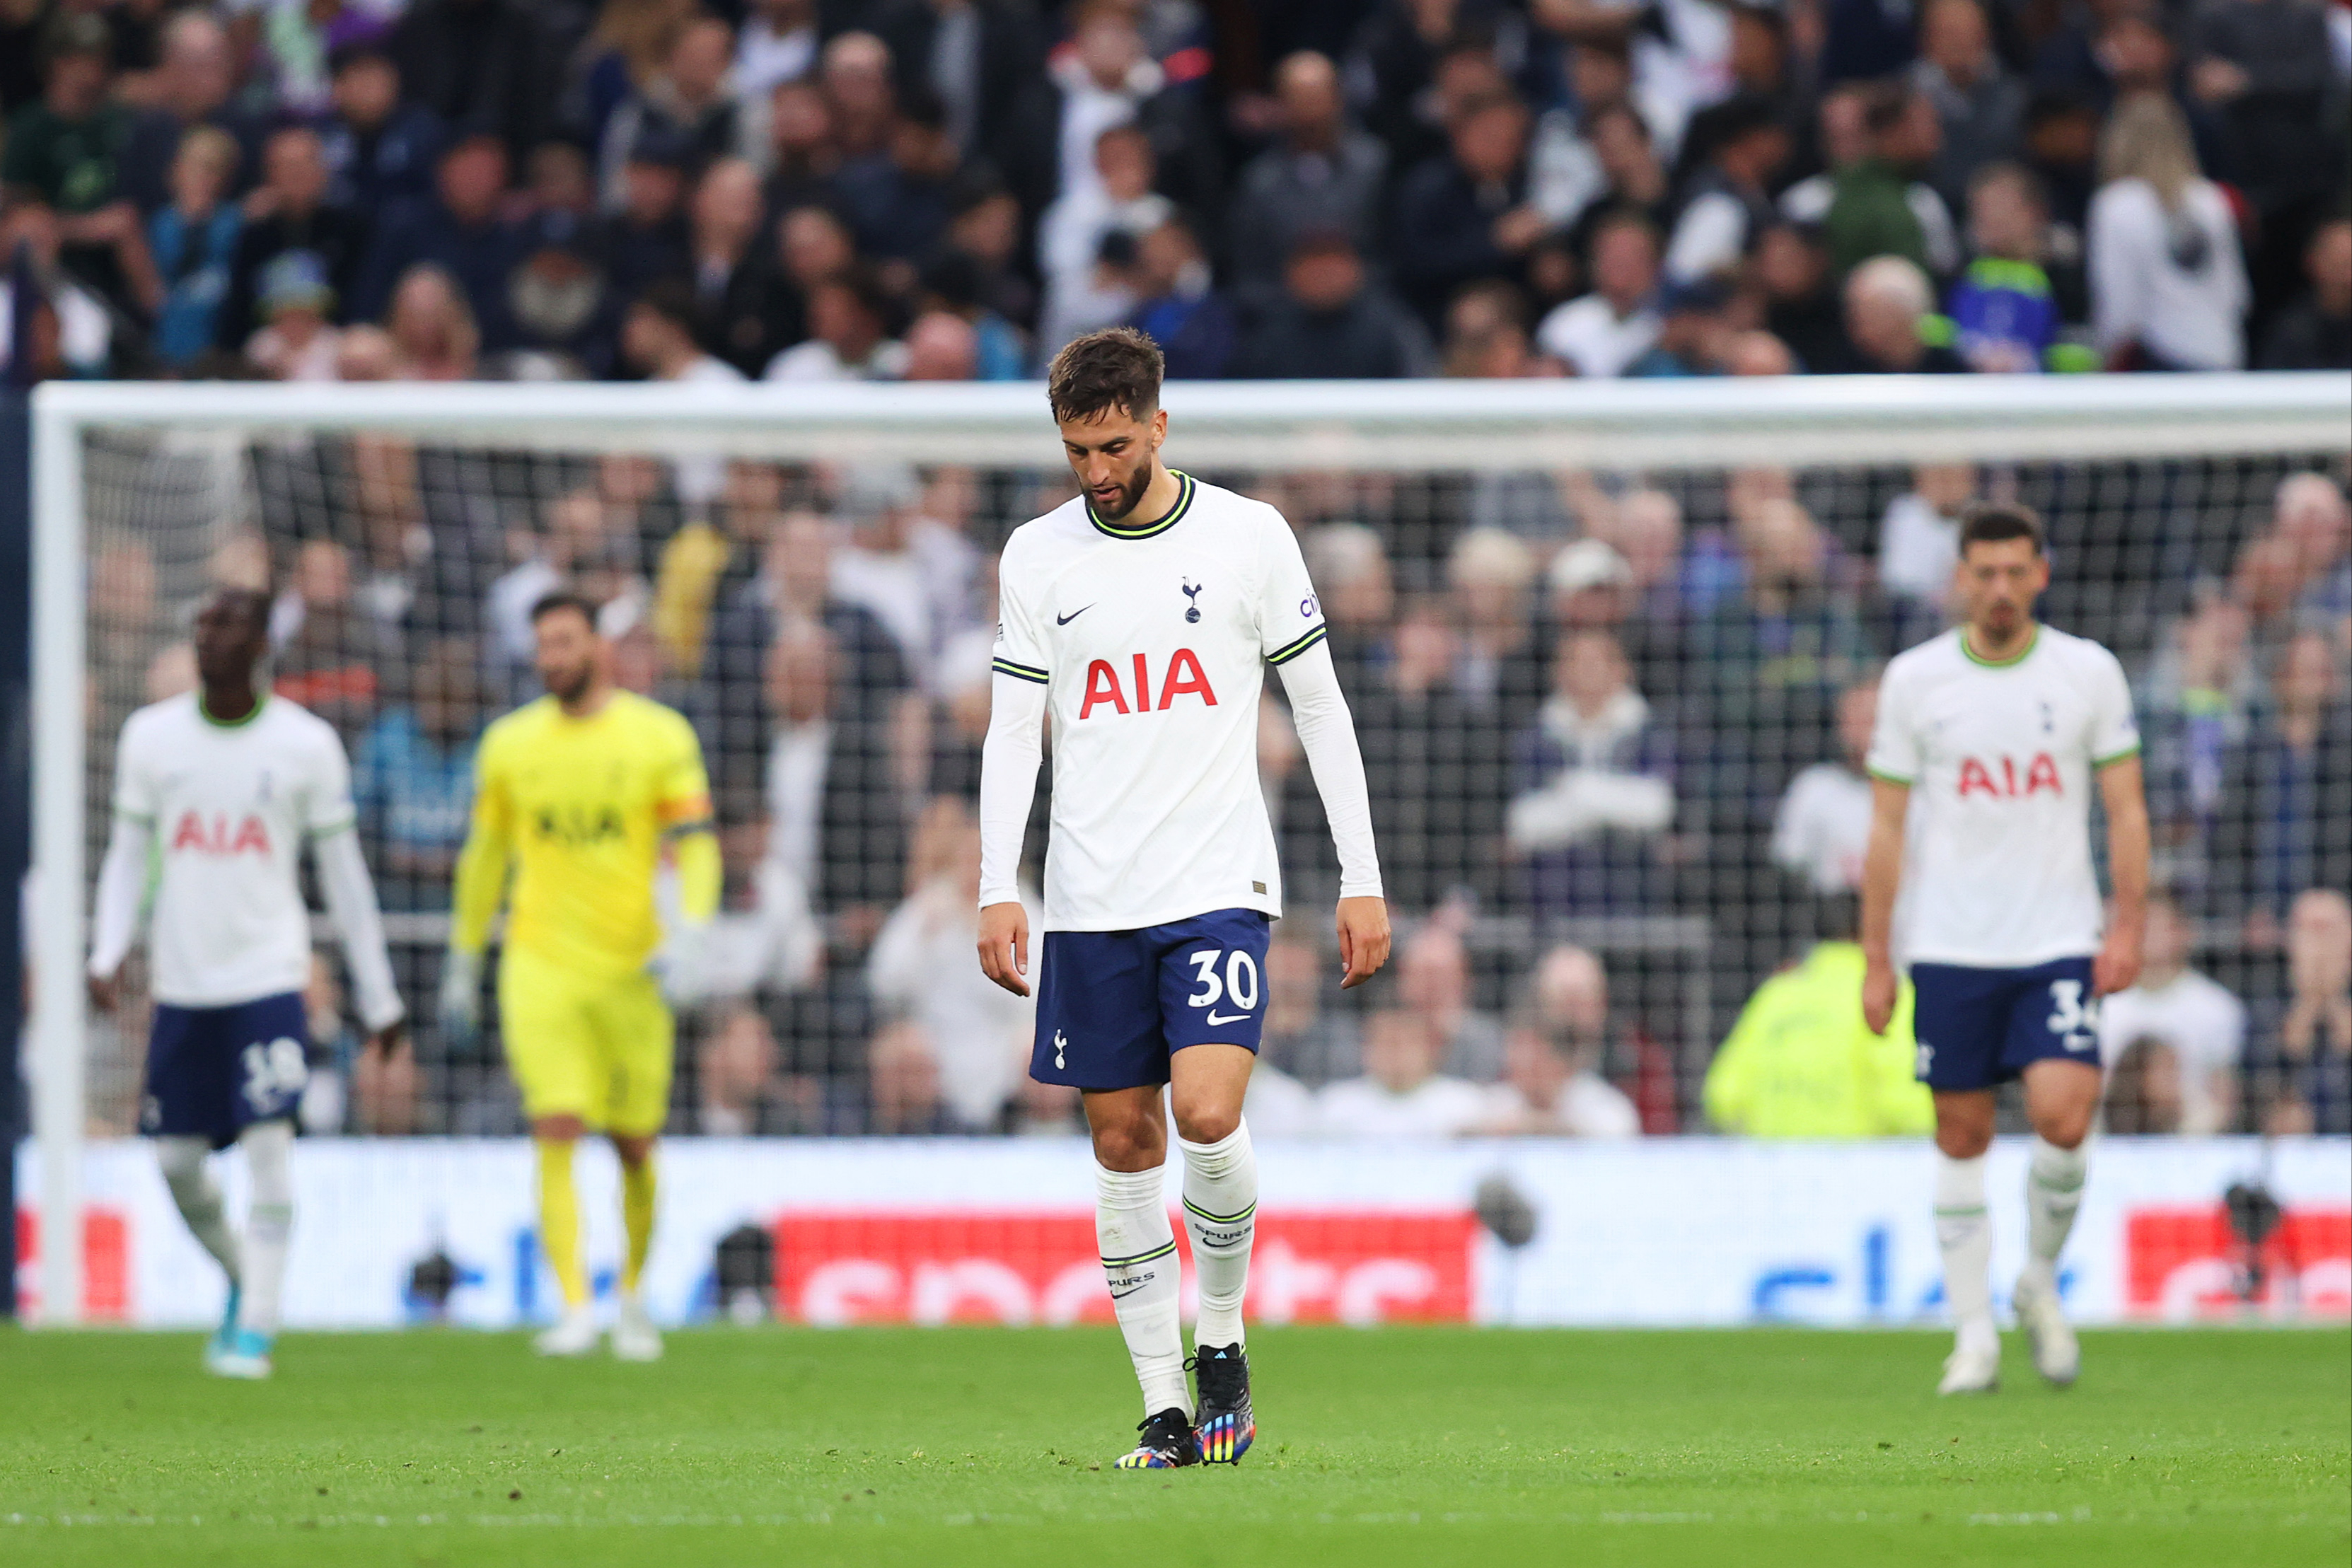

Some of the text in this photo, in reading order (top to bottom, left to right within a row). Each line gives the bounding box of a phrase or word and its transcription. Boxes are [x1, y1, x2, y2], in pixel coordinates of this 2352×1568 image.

[1079, 648, 1218, 720] AIA
[1959, 750, 2066, 798] AIA
[172, 808, 272, 854] AIA
[1188, 949, 1258, 1010] 30
[2046, 979, 2099, 1034] 3
[1194, 1224, 1252, 1240] SPURS
[1106, 1272, 1155, 1287] PURS
